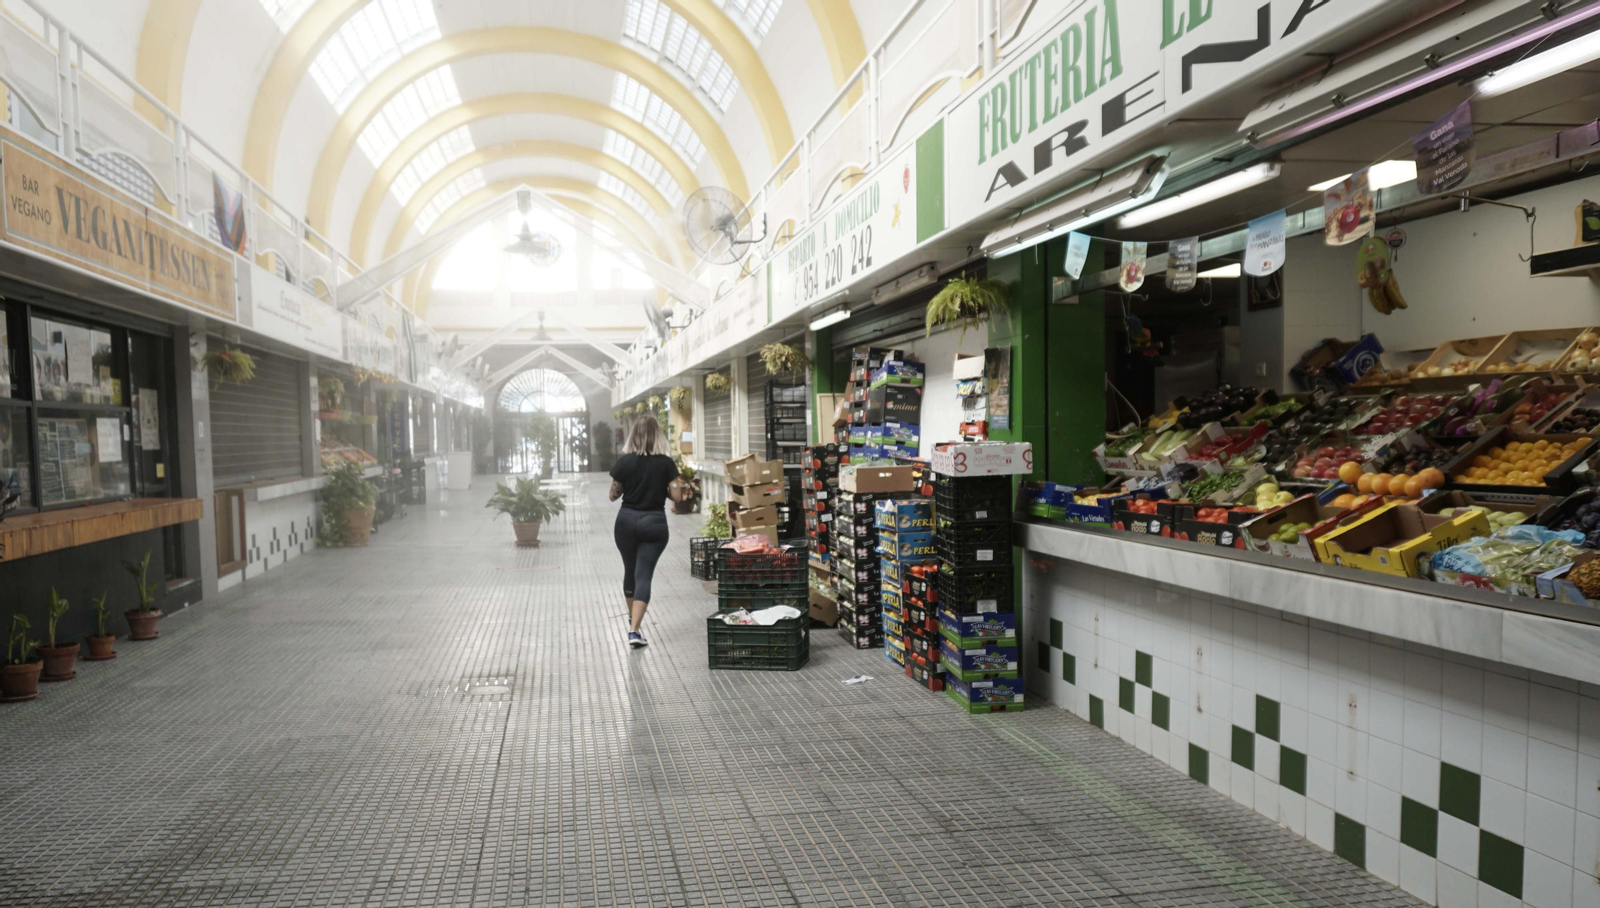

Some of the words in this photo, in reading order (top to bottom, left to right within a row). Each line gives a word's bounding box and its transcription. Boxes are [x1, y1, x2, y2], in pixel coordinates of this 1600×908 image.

[978, 0, 1124, 166] FRUTERIA
[1430, 121, 1455, 141] Gana
[1433, 176, 1445, 186] Val
[1444, 162, 1468, 180] Venosta
[1435, 155, 1464, 176] Manzanas
[22, 174, 40, 197] BAR
[11, 194, 52, 226] VEGANO
[788, 231, 816, 274] REPARTO
[822, 222, 828, 249] A
[835, 180, 880, 241] DOMICILIO
[54, 185, 212, 293] VEGANITESSEN
[803, 259, 819, 301] 954
[825, 243, 843, 290] 220
[851, 224, 873, 276] 242
[912, 518, 936, 527] PERL
[1088, 514, 1105, 523] Virtudes
[913, 546, 938, 555] PERL
[882, 592, 900, 609] PERLA
